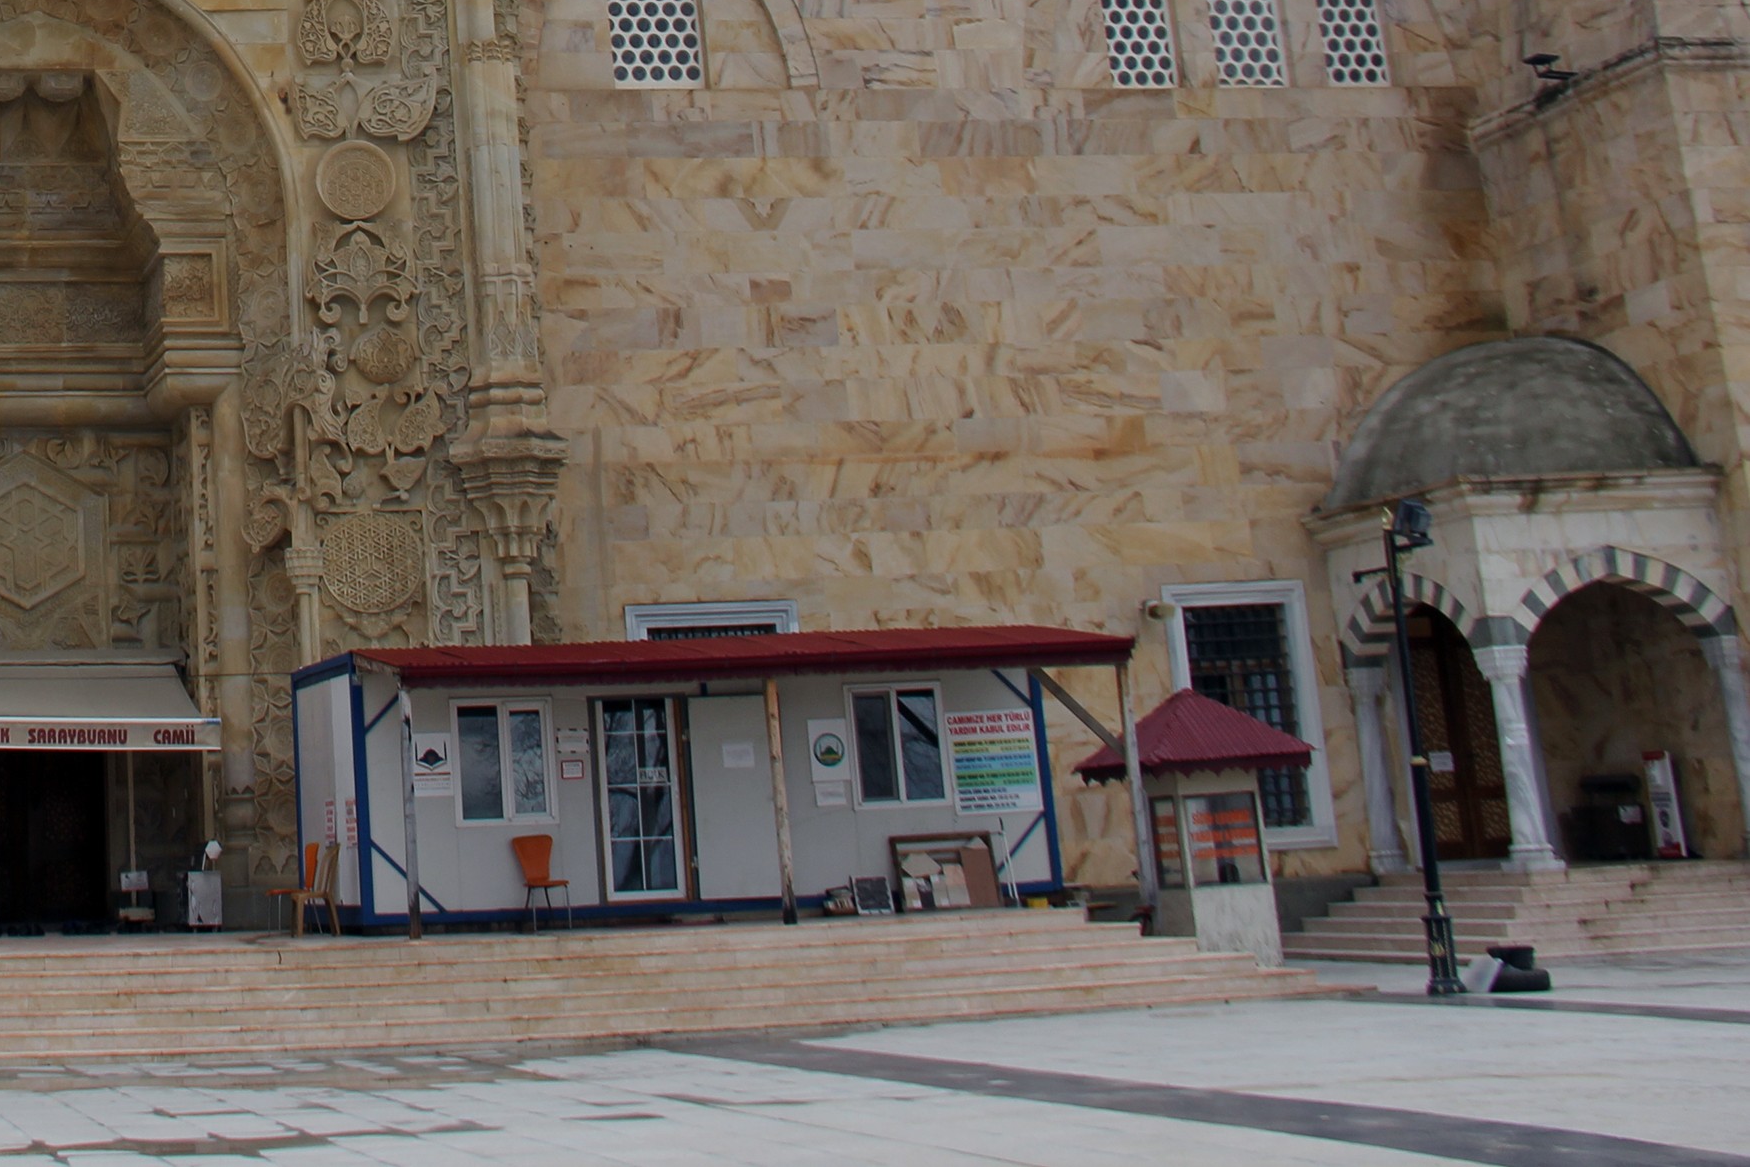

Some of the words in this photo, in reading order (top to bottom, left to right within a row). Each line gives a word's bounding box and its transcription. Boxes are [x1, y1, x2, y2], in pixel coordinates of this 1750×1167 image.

[985, 713, 1003, 723] HER
[979, 725, 1004, 734] KABUL
[27, 727, 128, 744] SARAYBURNU
